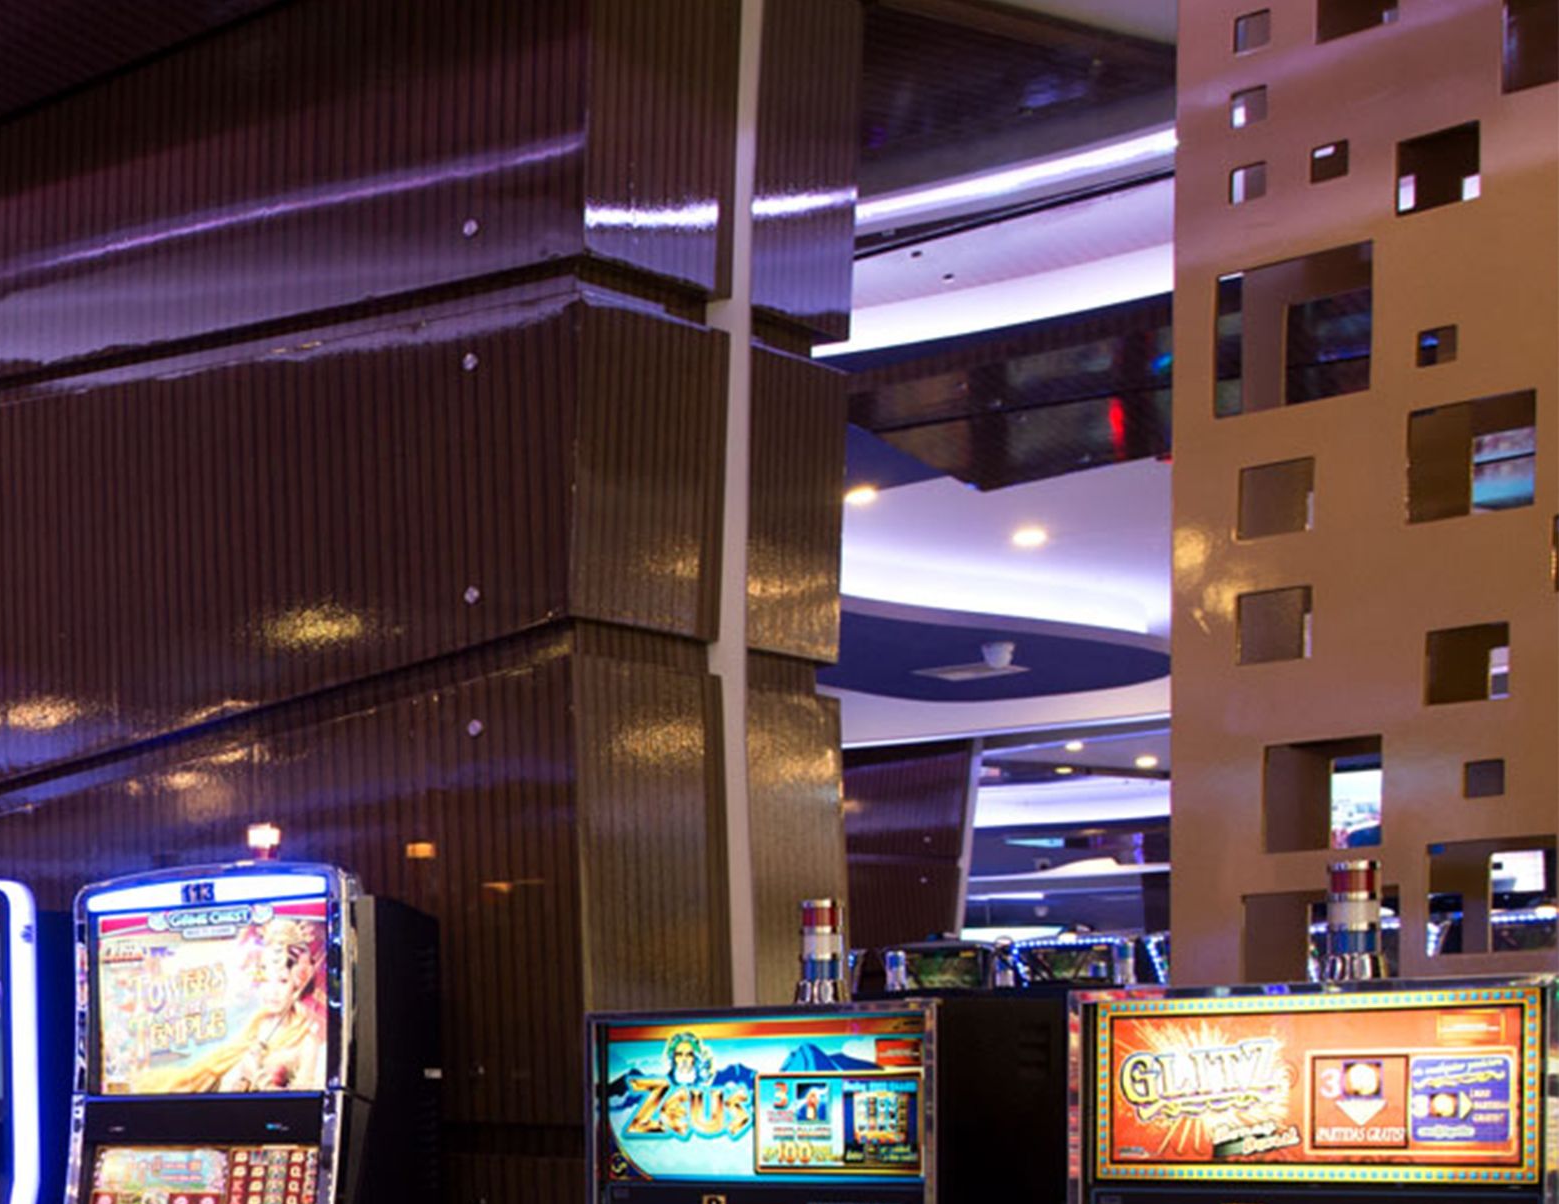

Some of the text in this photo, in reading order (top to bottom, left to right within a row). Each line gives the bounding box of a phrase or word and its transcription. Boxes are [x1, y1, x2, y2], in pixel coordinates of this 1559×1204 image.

[1120, 1037, 1275, 1105] GLITZ
[1320, 1067, 1340, 1099] 3
[773, 1083, 789, 1109] 3
